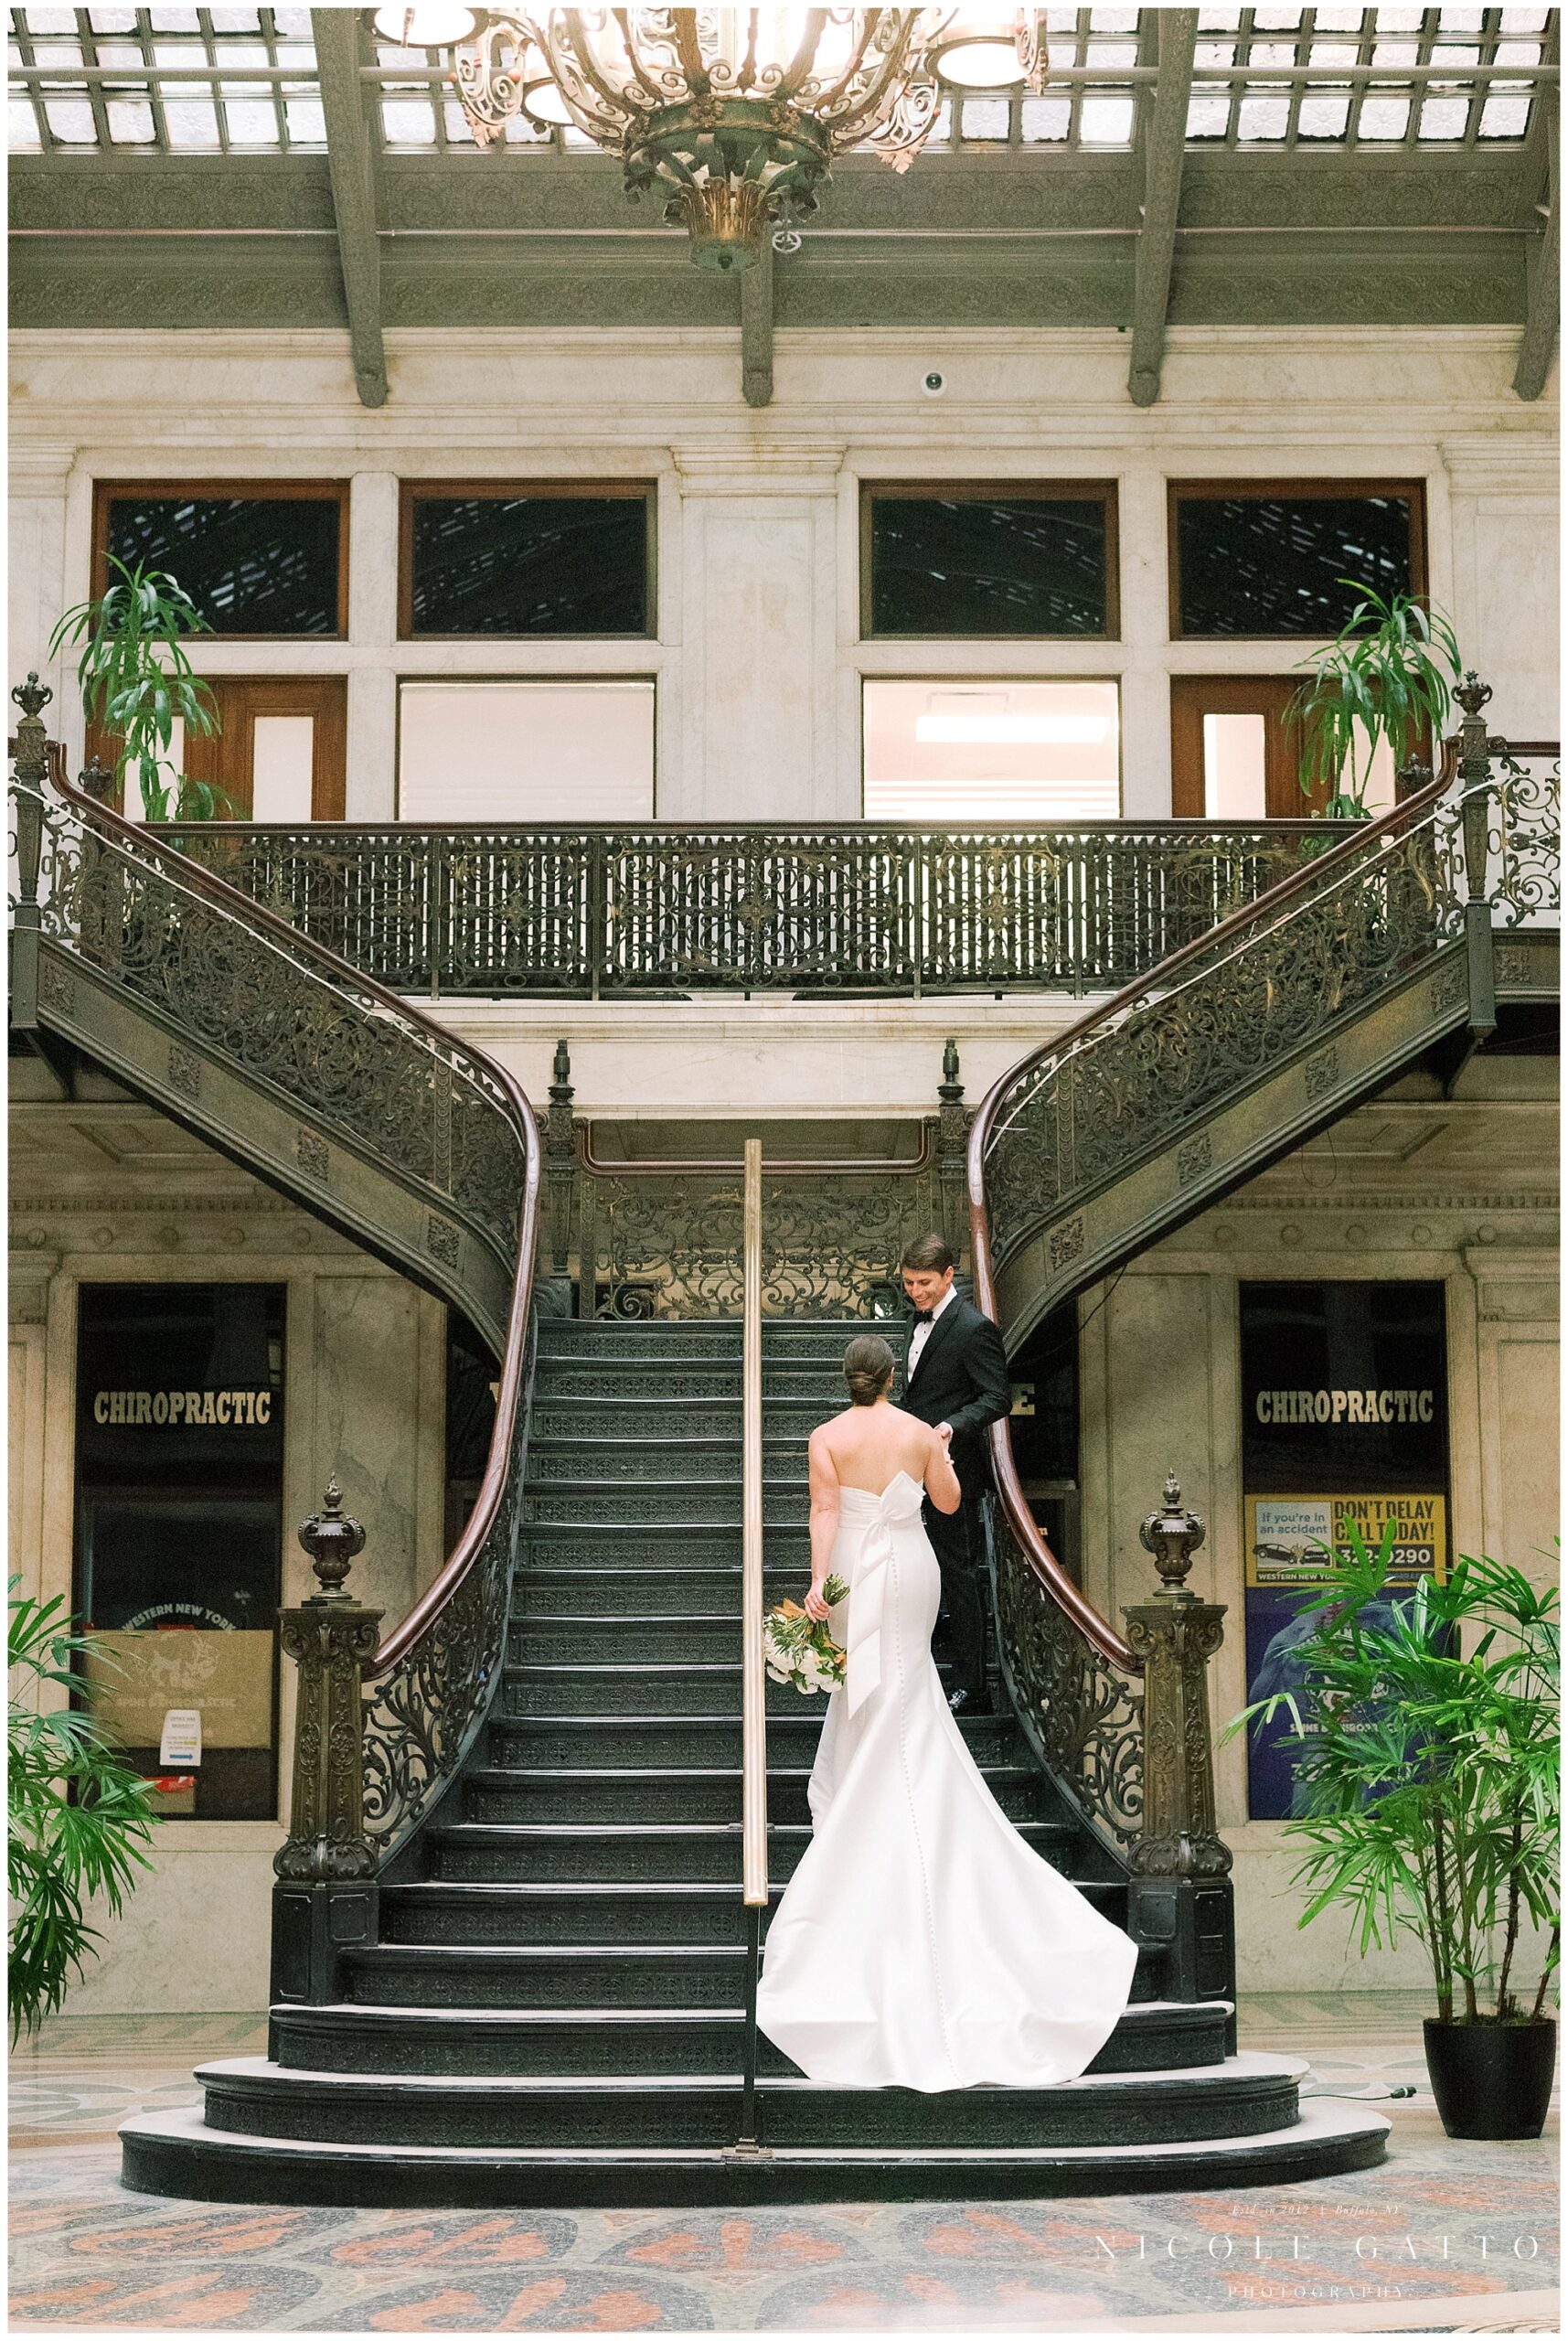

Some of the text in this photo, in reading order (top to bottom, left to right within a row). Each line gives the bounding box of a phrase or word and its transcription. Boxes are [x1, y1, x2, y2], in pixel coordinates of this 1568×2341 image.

[94, 1391, 271, 1425] CHIROPRACTIC
[1256, 1390, 1434, 1423] CHIROPRACTIC
[1262, 1513, 1272, 1523] If
[1273, 1513, 1311, 1524] you're
[1334, 1501, 1434, 1519] DON'T DELAY
[1260, 1524, 1328, 1534] an accident
[1335, 1522, 1435, 1541] CLL TDAY!
[1258, 1573, 1298, 1581] WESTERN
[1299, 1573, 1317, 1581] NEW
[121, 1603, 173, 1630] WESTERN
[175, 1603, 203, 1617] NEW
